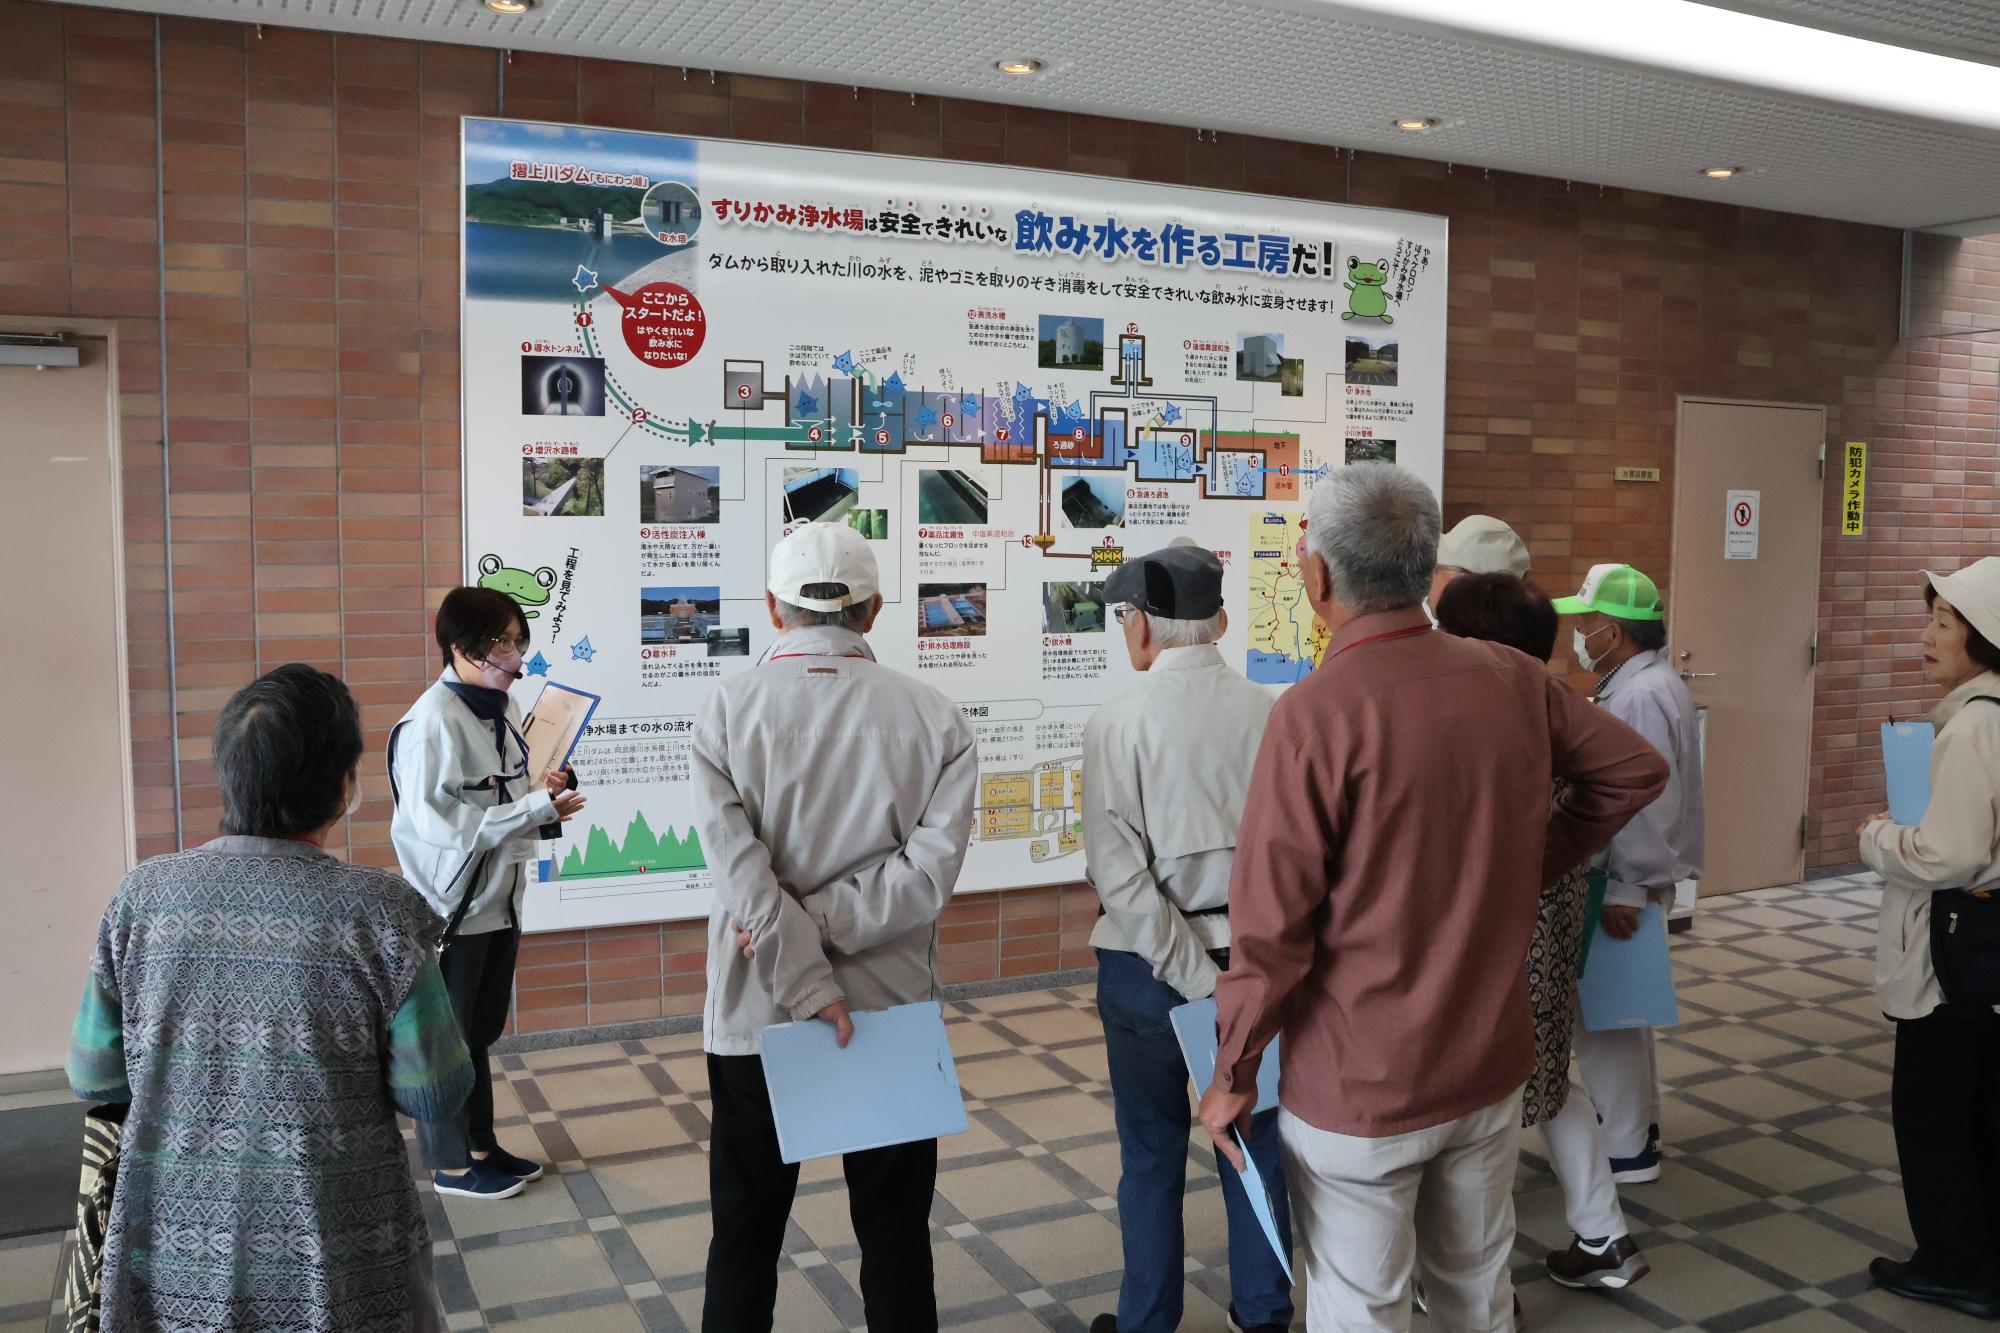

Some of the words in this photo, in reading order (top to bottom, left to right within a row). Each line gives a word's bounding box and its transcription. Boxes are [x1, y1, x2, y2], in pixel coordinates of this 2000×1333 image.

[660, 232, 687, 244] 取水塔
[642, 293, 689, 306] ここから
[625, 307, 702, 322] スタートだよ!
[637, 326, 695, 336] はやくきれいな
[533, 343, 581, 354] 導水トンネル
[648, 338, 683, 349] 飲み水に
[643, 351, 688, 361] なりたいな!
[1846, 446, 1863, 532] 防犯カメラ作動中
[552, 547, 580, 644] 工程を見てみよう!
